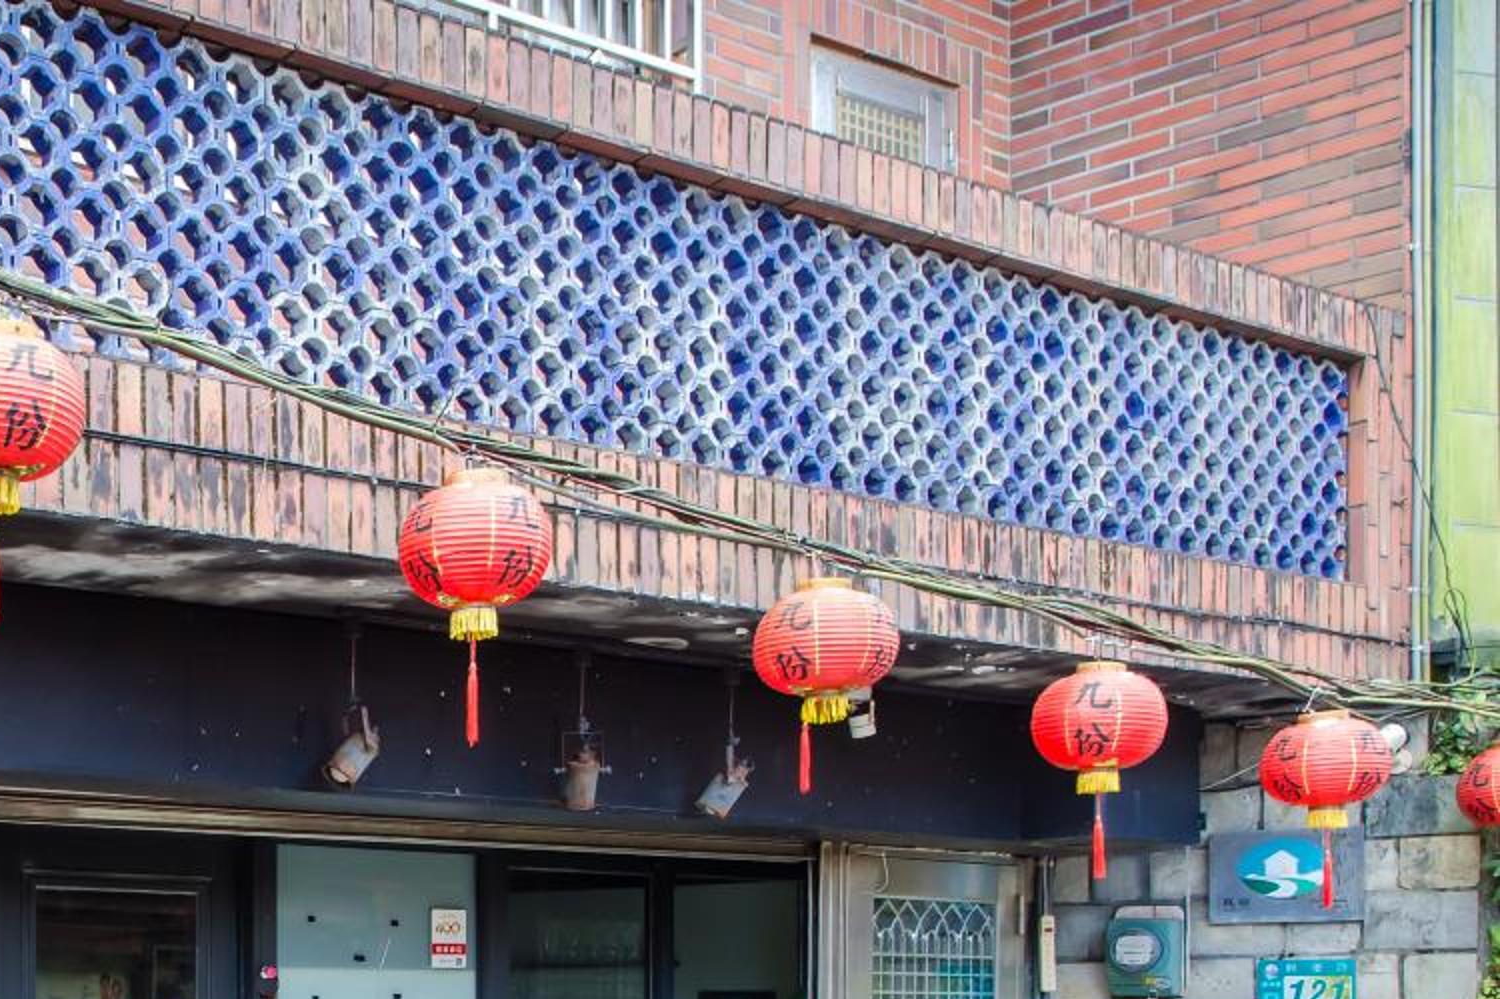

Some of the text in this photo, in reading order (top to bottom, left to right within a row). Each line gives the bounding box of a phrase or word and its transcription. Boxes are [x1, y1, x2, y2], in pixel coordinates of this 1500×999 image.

[5, 343, 55, 451] 九份
[499, 495, 540, 589] 九份
[774, 601, 813, 681] 九份
[1074, 681, 1117, 757] 九份
